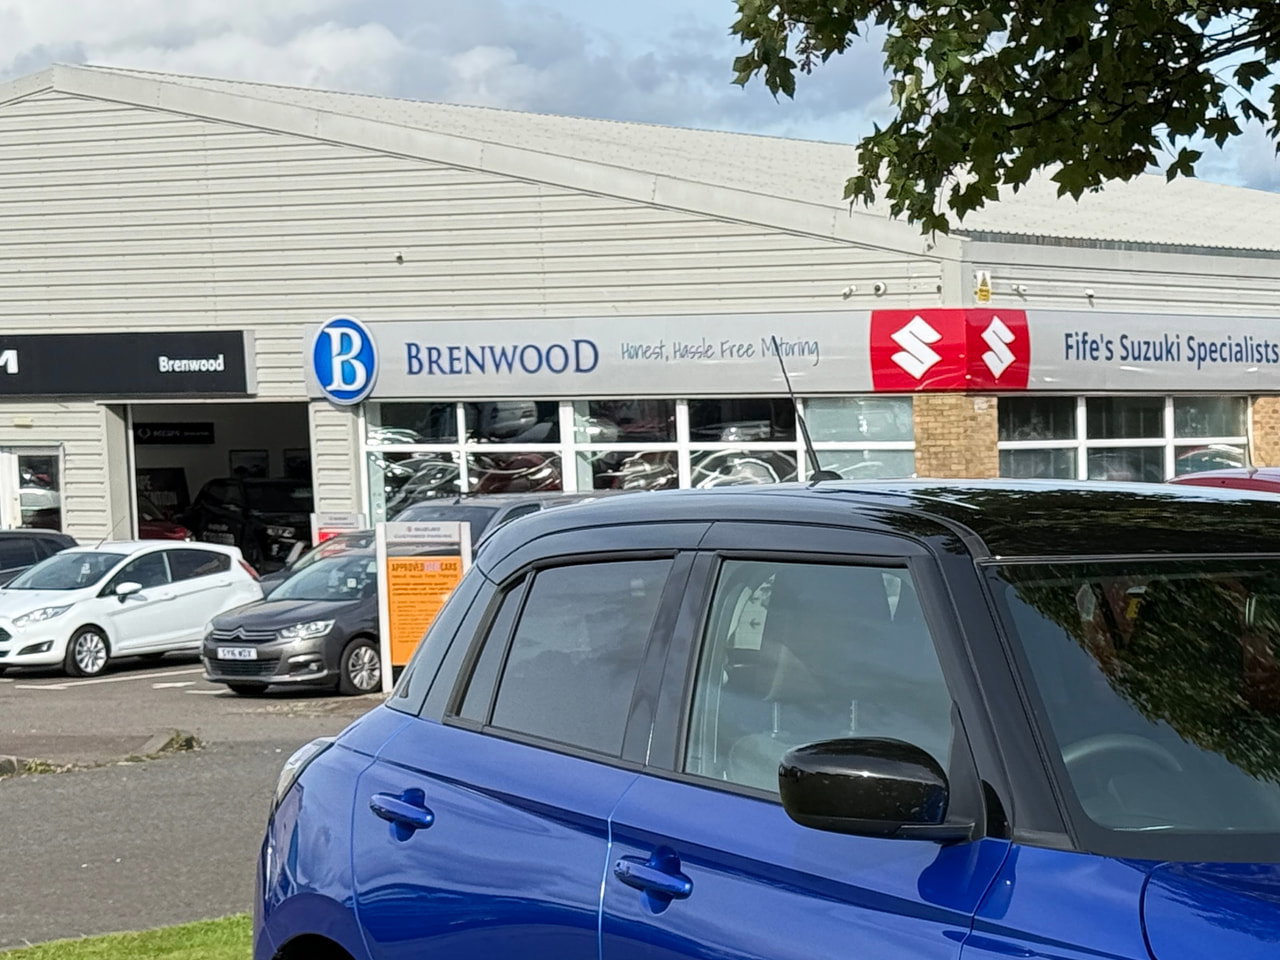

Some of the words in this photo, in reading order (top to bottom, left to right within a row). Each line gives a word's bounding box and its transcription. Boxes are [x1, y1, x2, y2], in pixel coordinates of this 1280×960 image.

[158, 354, 225, 373] Brenwood
[321, 326, 368, 392] B
[405, 339, 600, 376] BRENWOOD
[621, 340, 670, 362] Honest,
[673, 337, 715, 360] Hassle
[720, 339, 756, 359] Free
[761, 336, 820, 367] Mtoring
[1064, 332, 1114, 362] Fife's
[1119, 333, 1181, 363] Suzuki
[1186, 335, 1280, 370] Specialists
